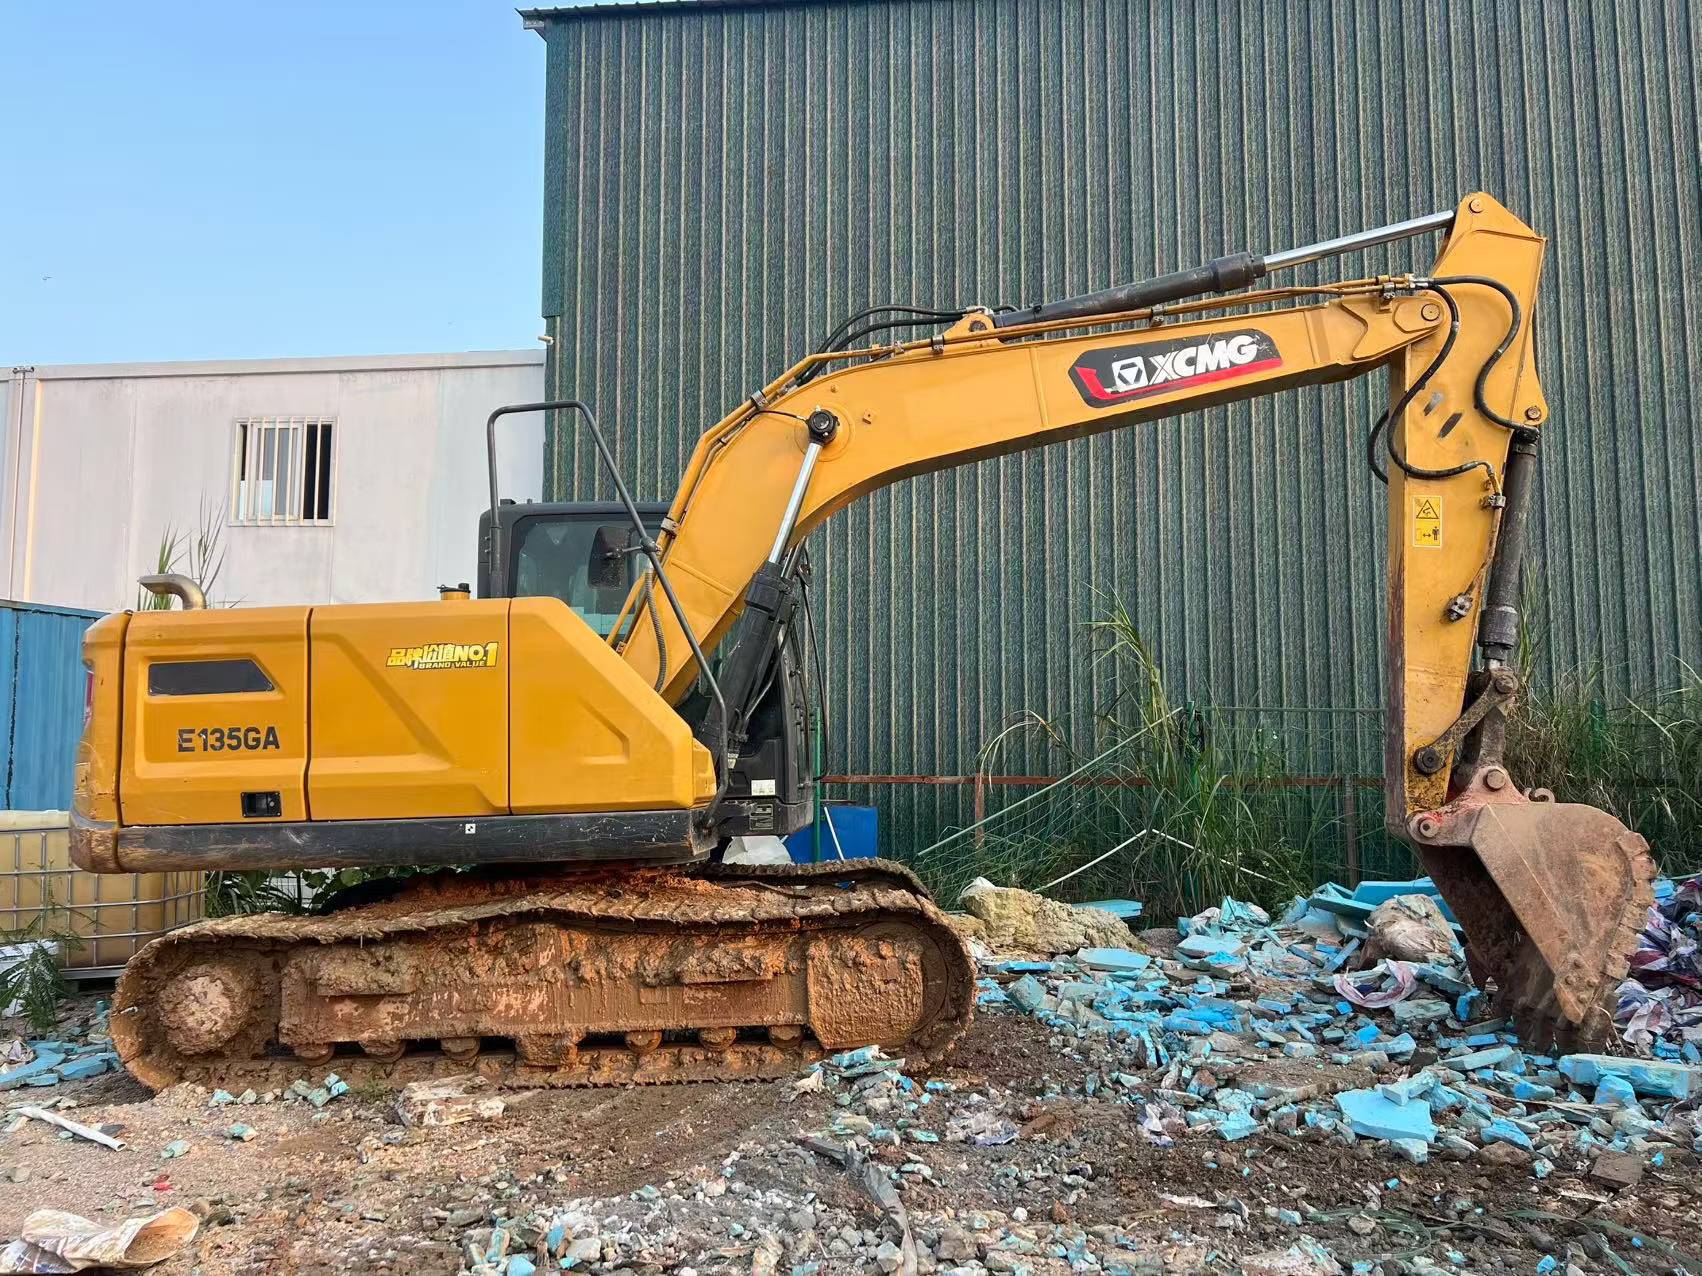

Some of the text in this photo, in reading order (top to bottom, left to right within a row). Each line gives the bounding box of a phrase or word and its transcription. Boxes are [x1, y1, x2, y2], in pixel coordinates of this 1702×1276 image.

[1149, 334, 1258, 385] XCMG
[419, 660, 486, 670] BRAND VALUE
[177, 726, 280, 752] E135GA
